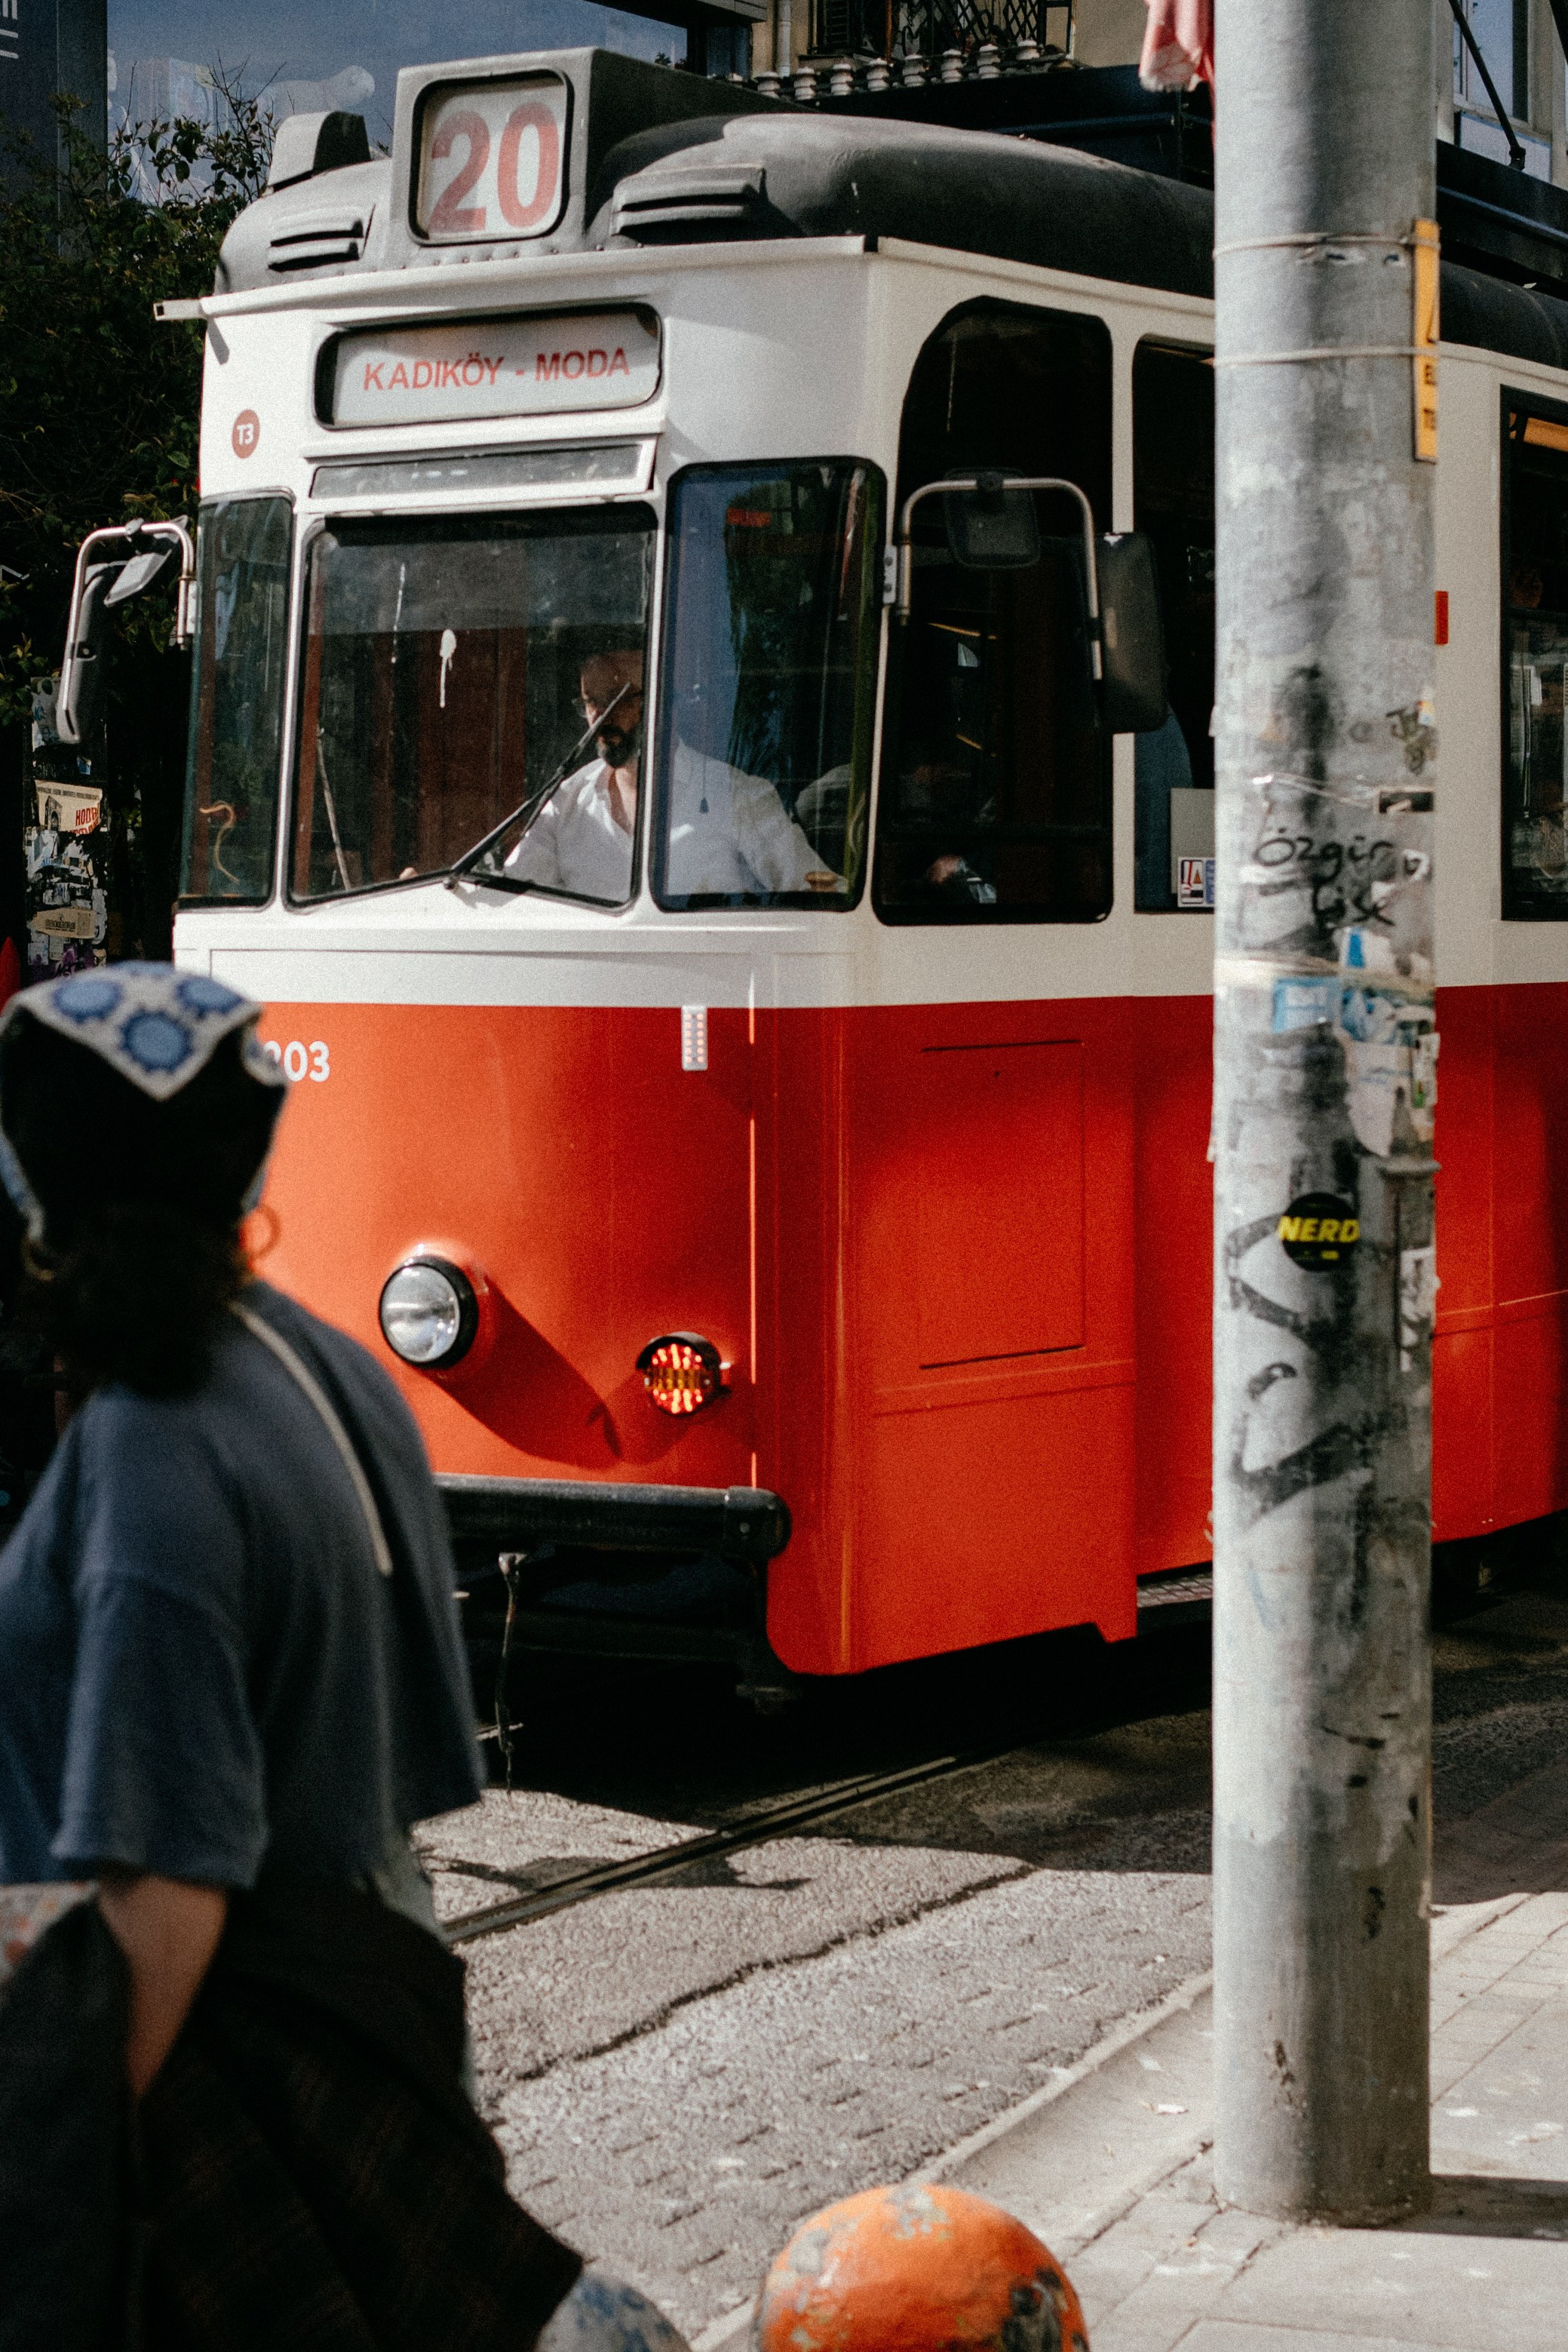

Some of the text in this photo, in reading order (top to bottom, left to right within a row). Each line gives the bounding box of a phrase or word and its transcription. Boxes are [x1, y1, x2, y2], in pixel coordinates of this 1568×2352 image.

[428, 101, 560, 233] 20
[364, 352, 505, 391] KADIKÖY
[535, 347, 631, 382] MODA
[237, 422, 254, 447] T3
[1278, 1215, 1361, 1245] NERD
